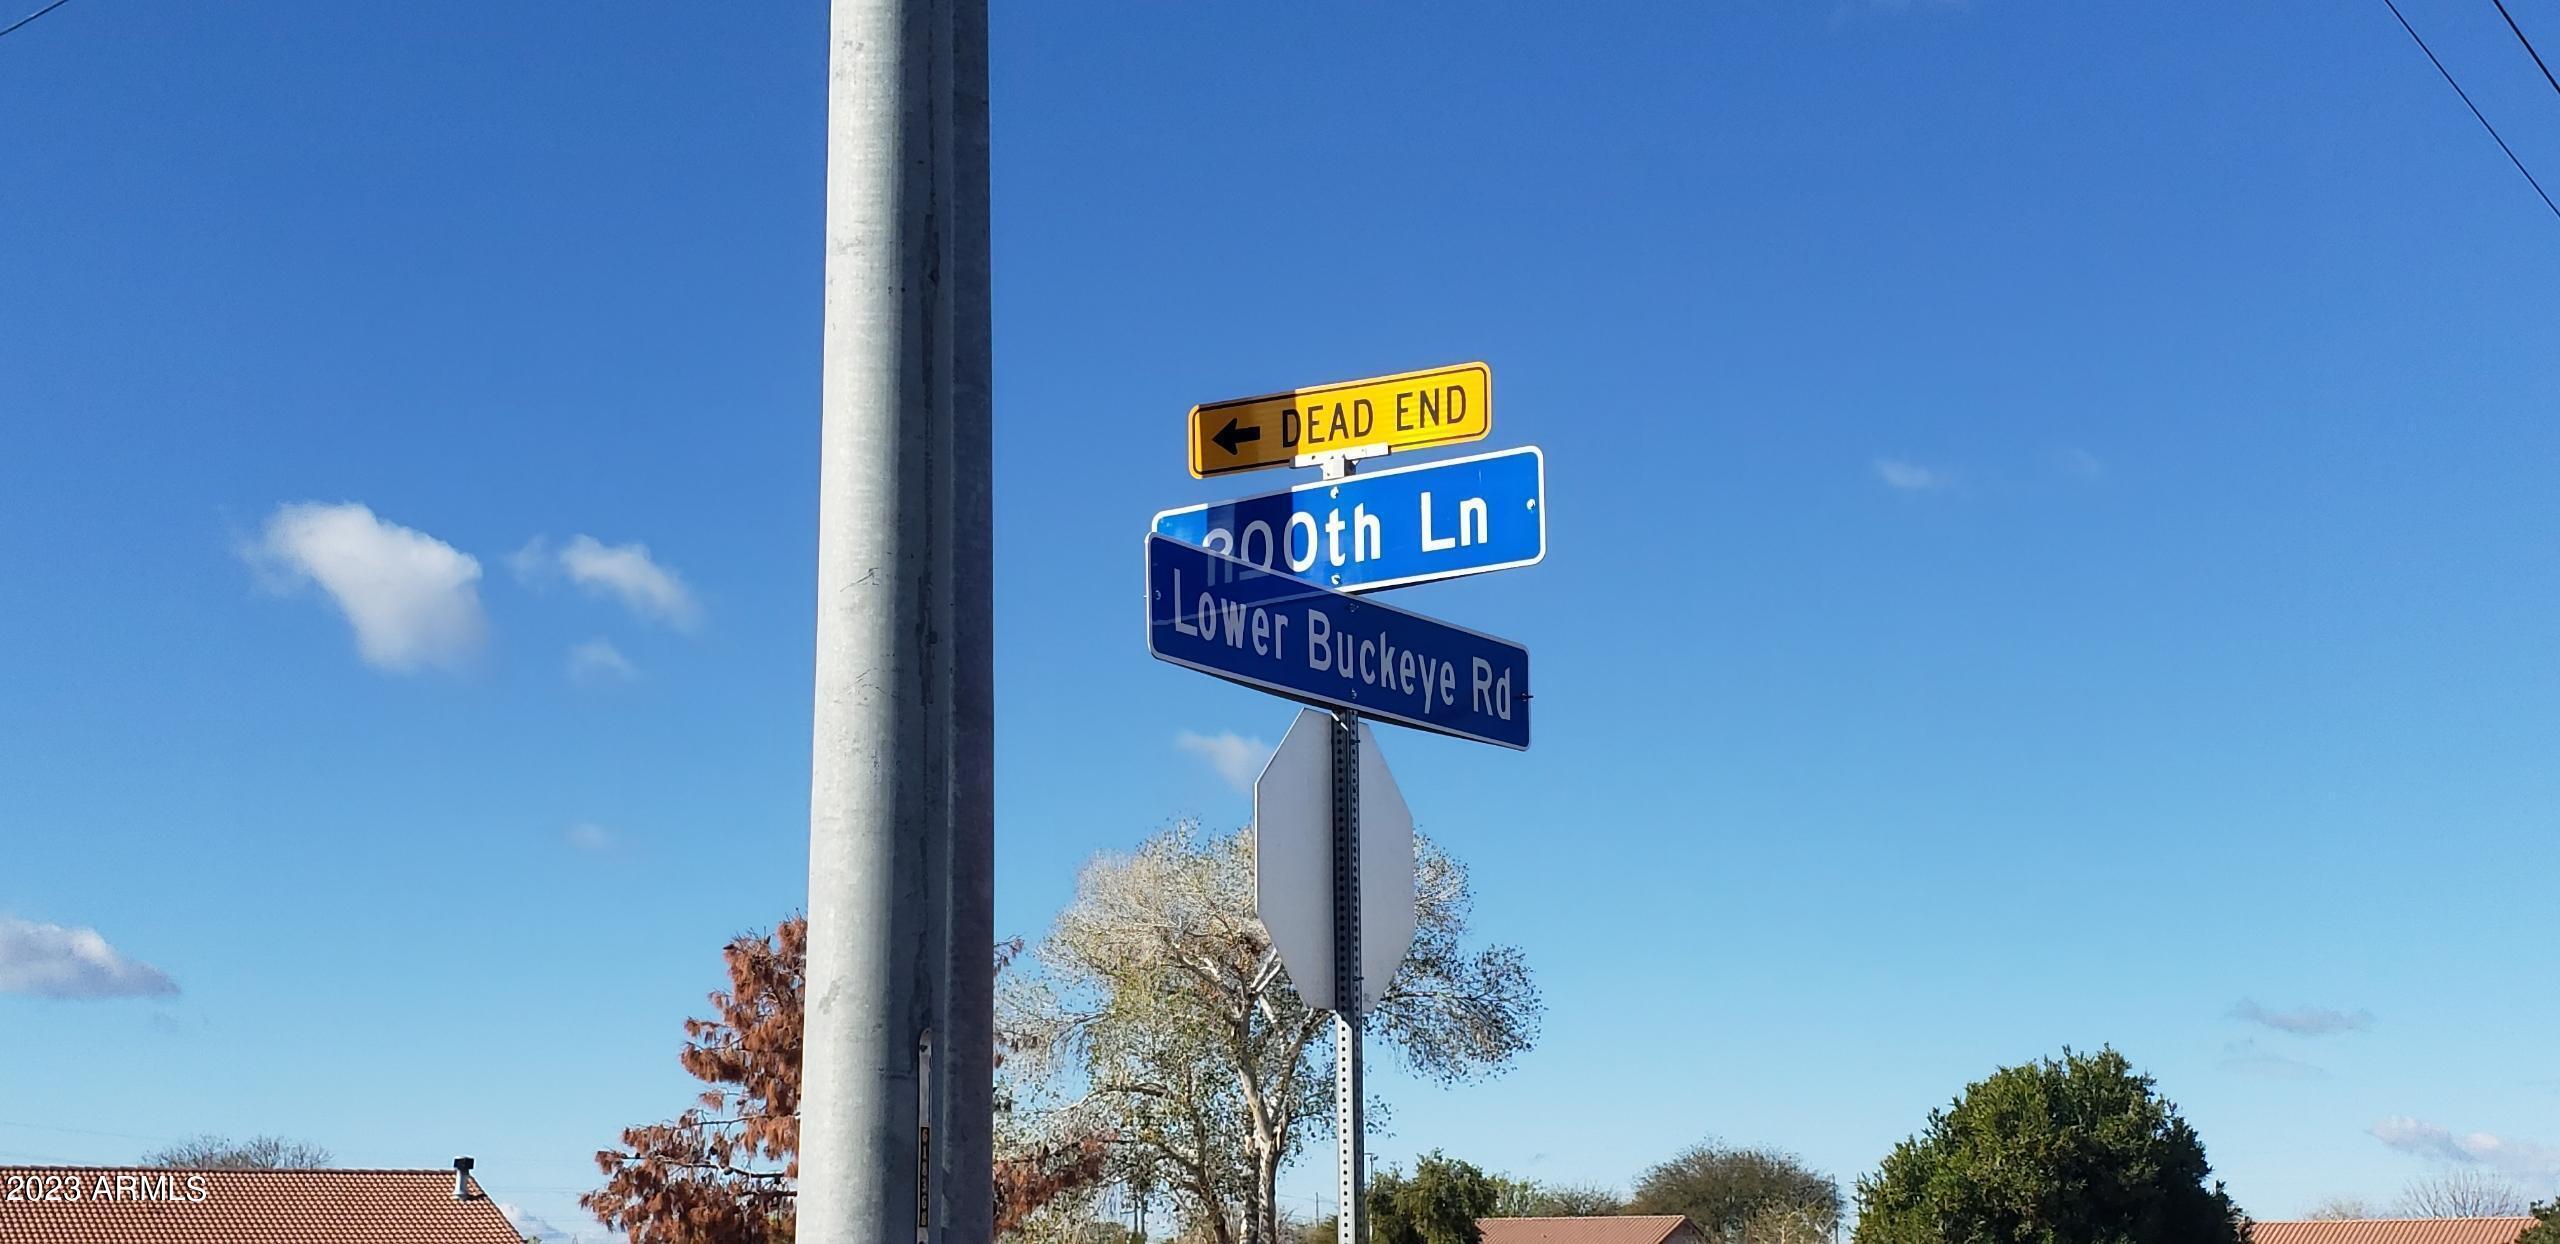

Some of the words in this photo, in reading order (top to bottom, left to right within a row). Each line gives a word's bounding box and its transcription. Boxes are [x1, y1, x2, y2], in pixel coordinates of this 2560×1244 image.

[1281, 398, 1374, 448] DEAD
[1396, 385, 1468, 432] END
[1421, 491, 1488, 553] Ln
[1173, 567, 1289, 661] Lower
[1308, 608, 1456, 714] Buckeye
[1472, 655, 1512, 721] Rd
